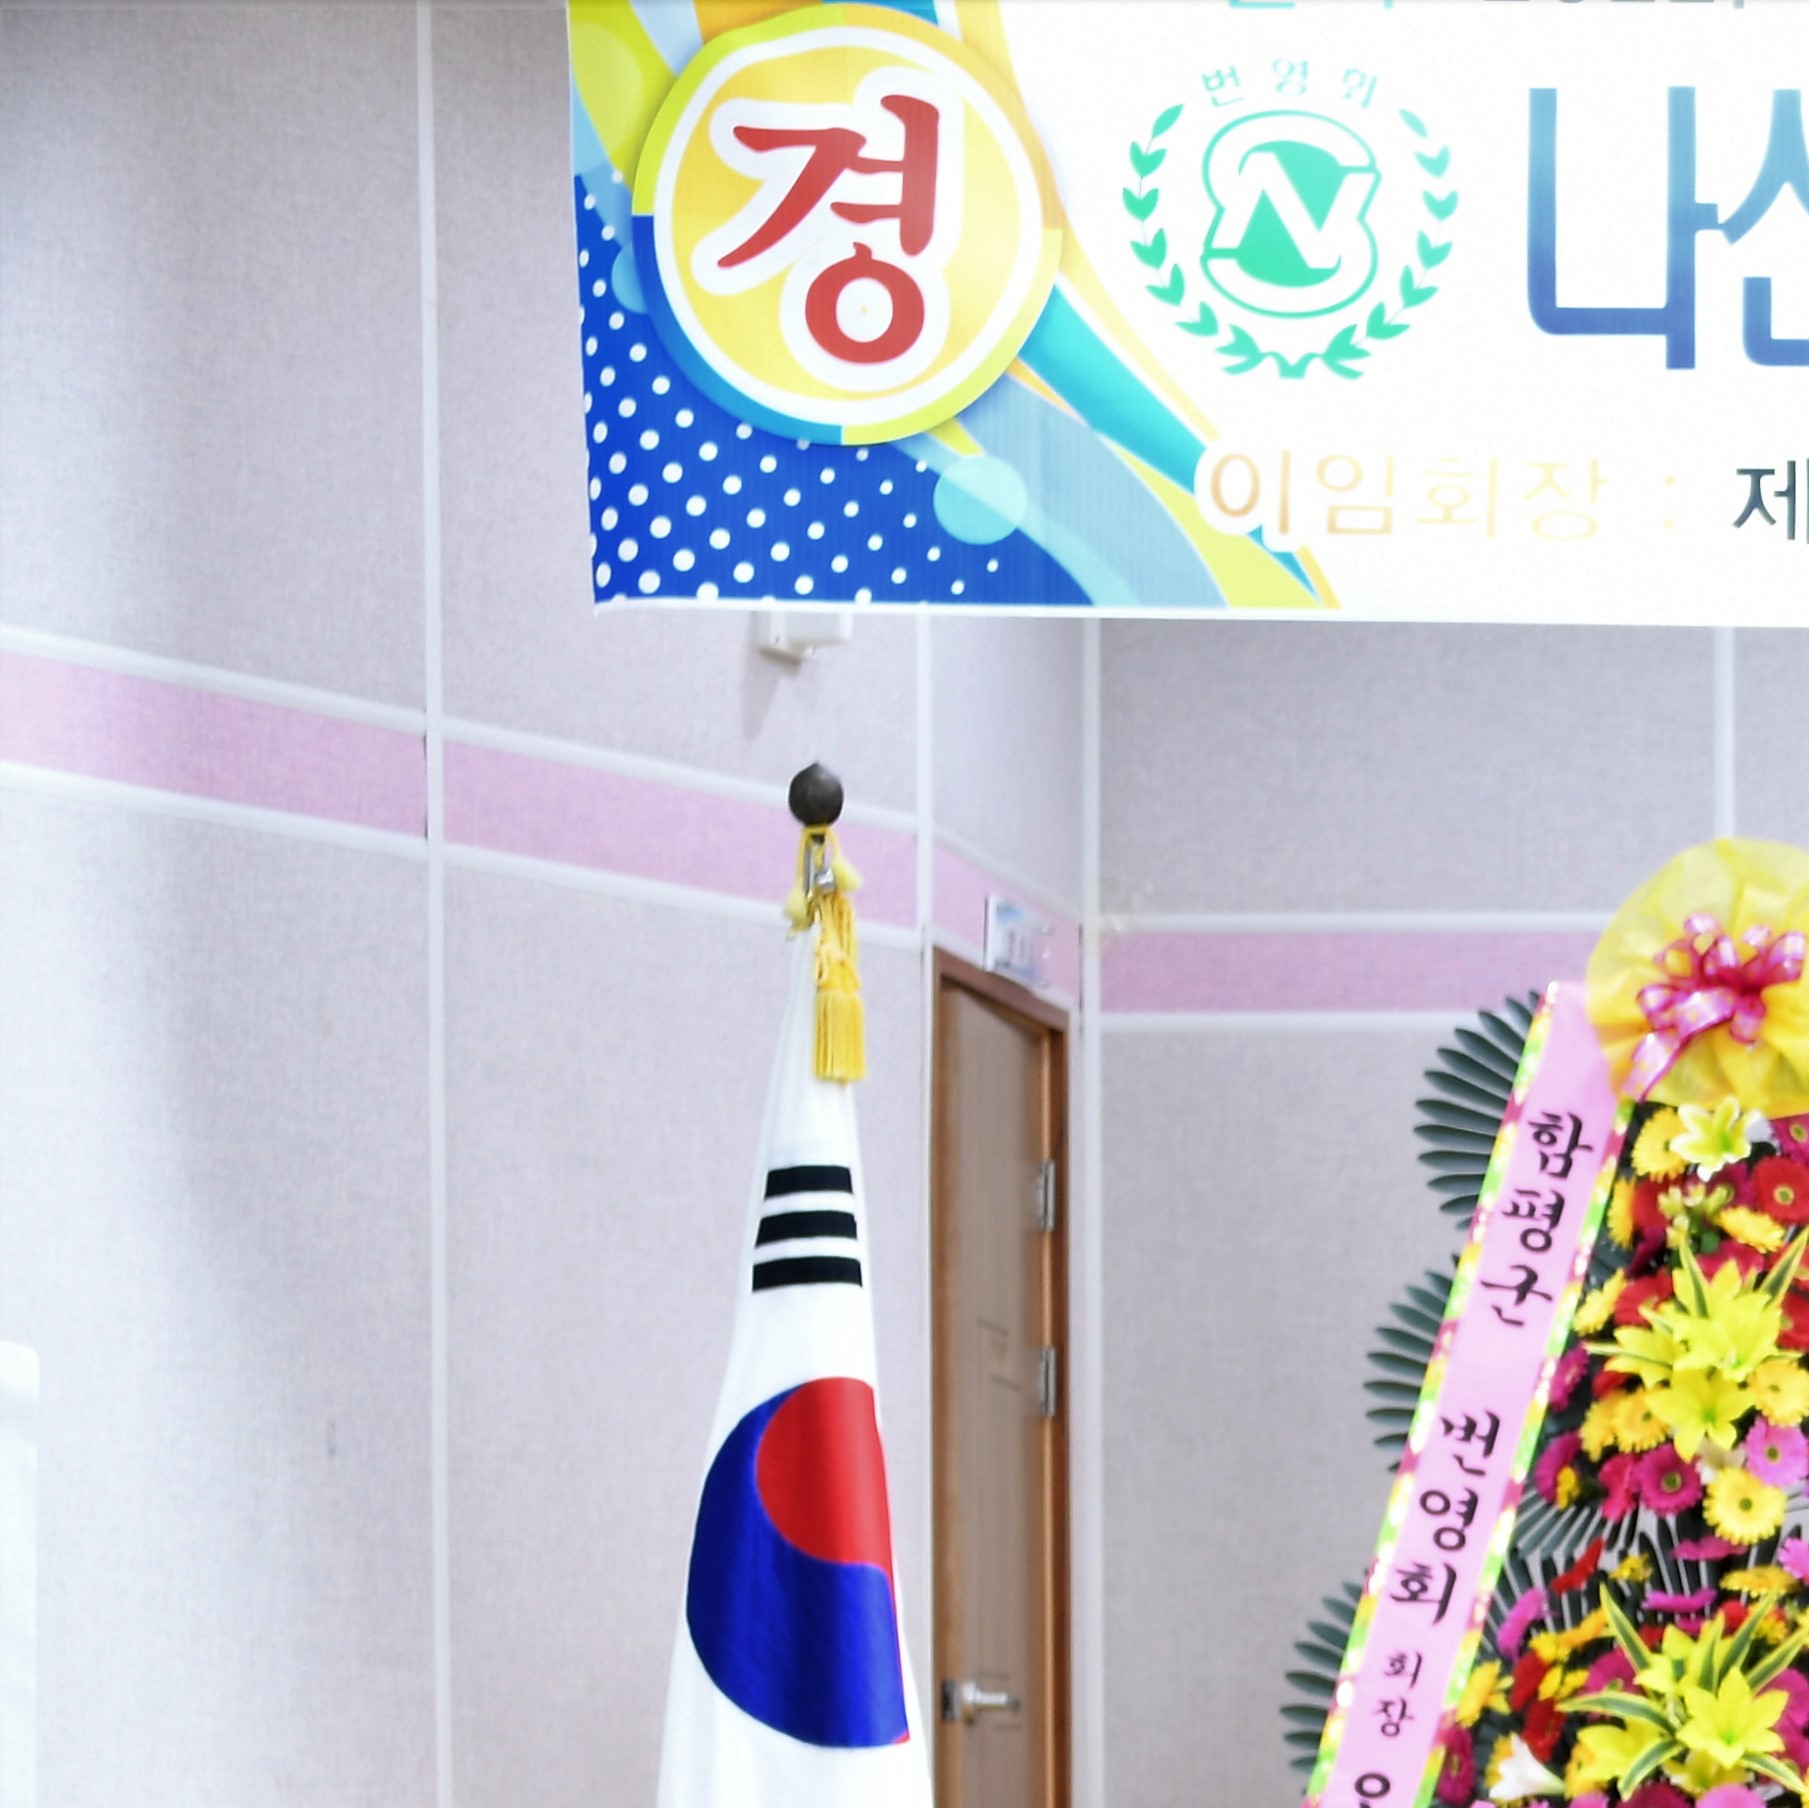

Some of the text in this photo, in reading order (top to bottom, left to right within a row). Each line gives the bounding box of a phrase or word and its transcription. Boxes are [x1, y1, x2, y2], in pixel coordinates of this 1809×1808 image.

[715, 96, 936, 365] 경
[1210, 448, 1610, 542] 이임회장
[1480, 1110, 1592, 1326] 함평군
[1391, 1408, 1500, 1624] 번영회
[1372, 1650, 1424, 1738] 회장
